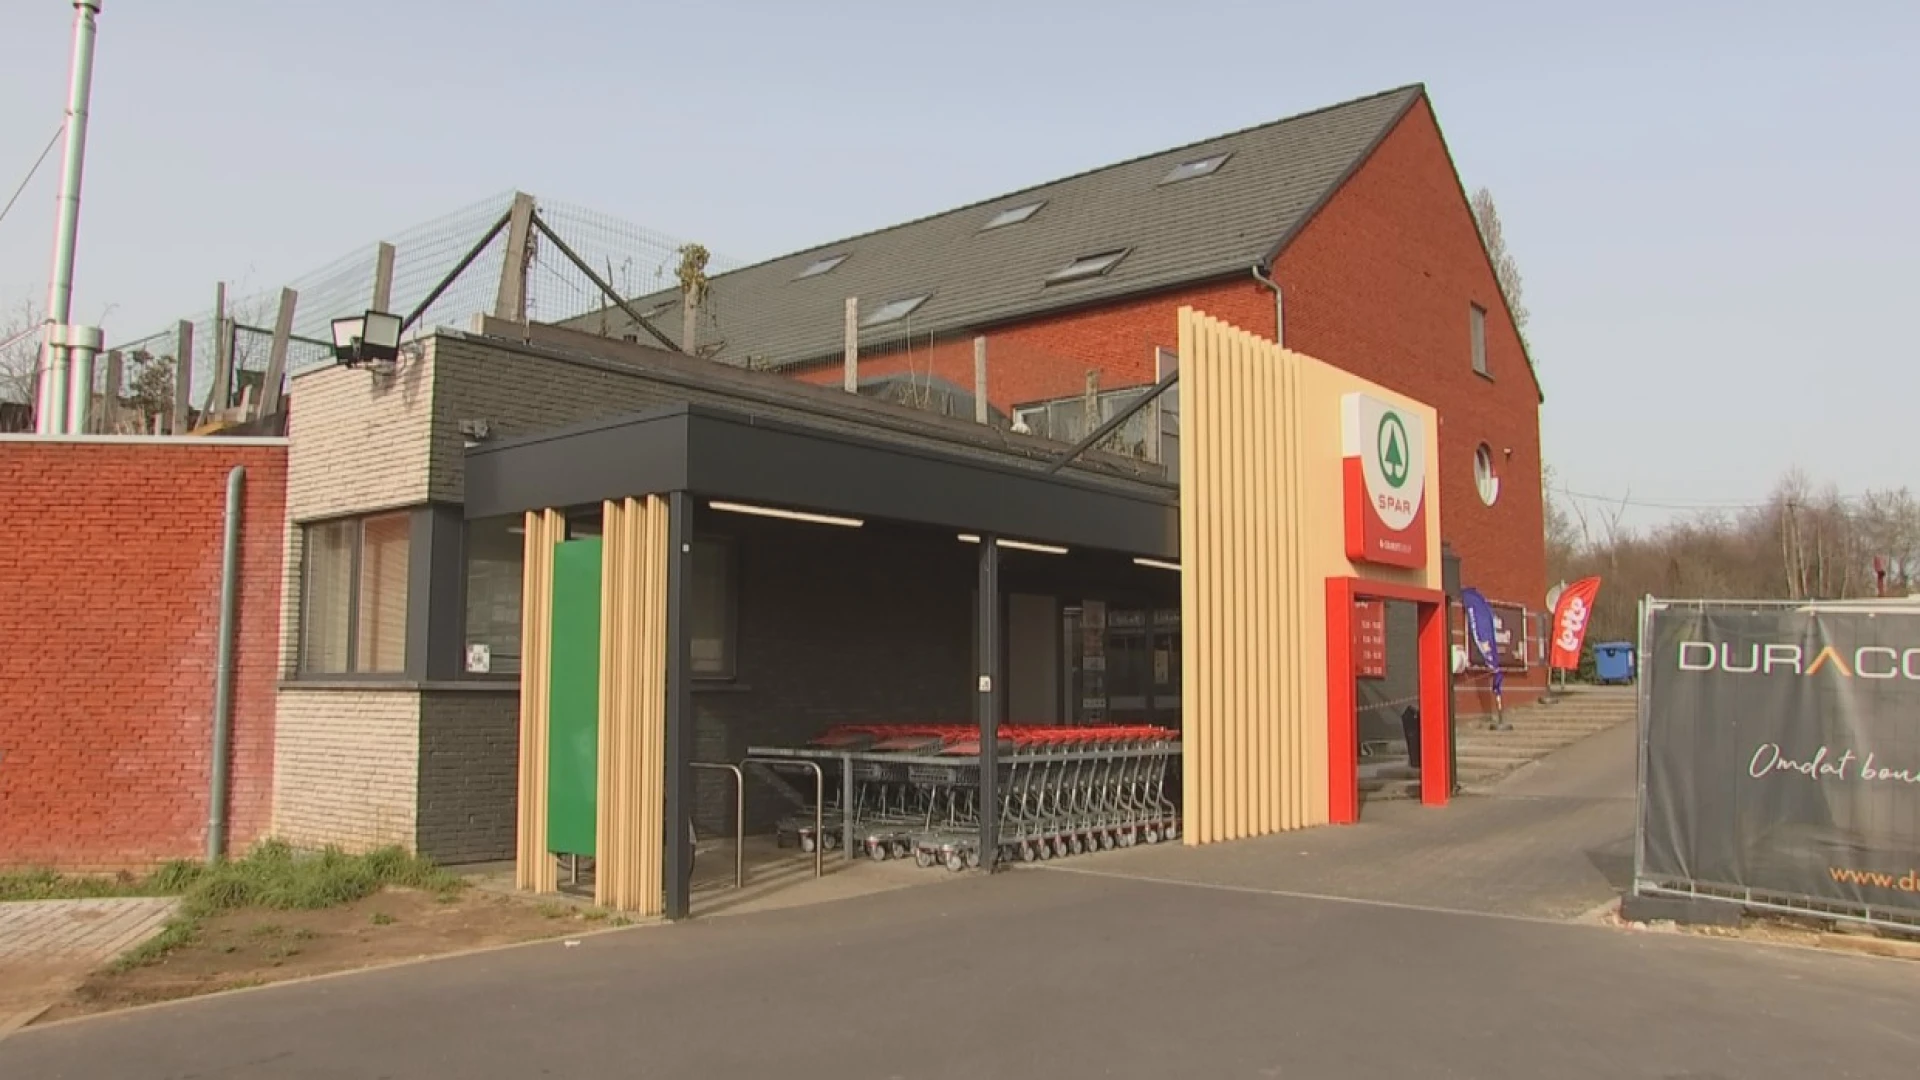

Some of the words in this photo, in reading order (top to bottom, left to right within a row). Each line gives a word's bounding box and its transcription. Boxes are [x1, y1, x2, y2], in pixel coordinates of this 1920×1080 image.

[1378, 494, 1411, 515] SPAR
[1749, 743, 1855, 780] Omdat
[1861, 752, 1920, 782] bou
[1830, 866, 1920, 892] www.d
